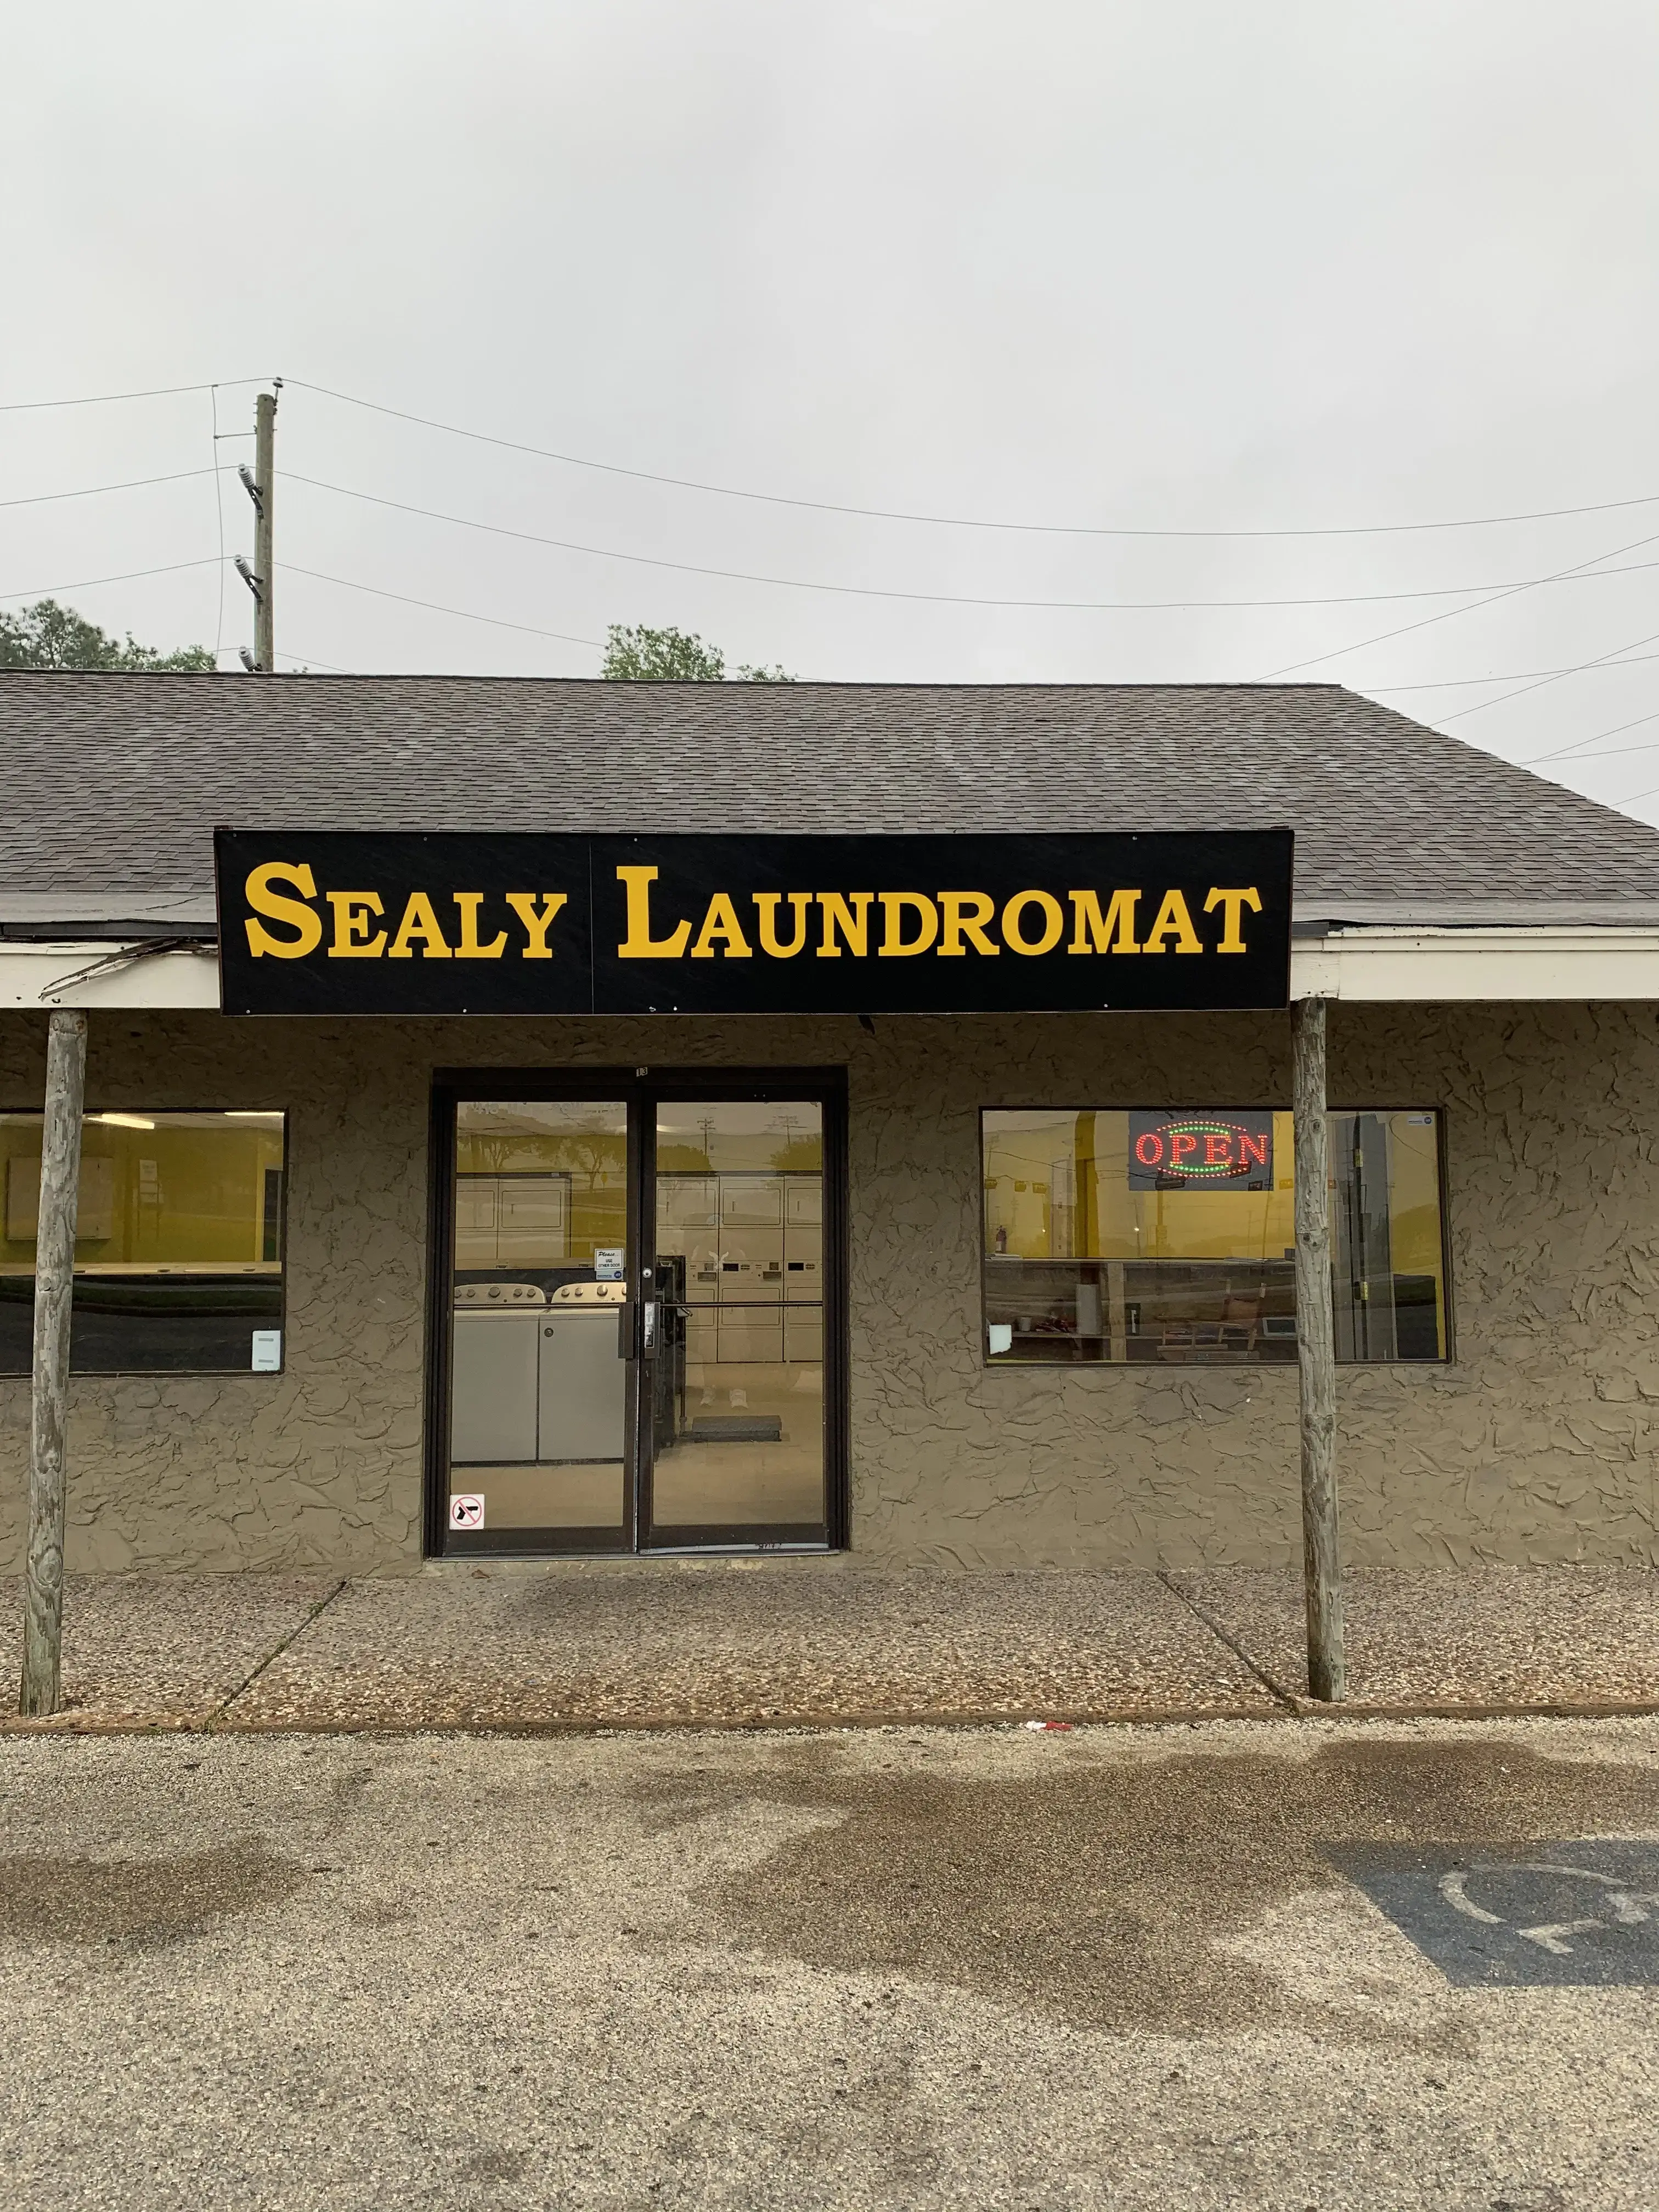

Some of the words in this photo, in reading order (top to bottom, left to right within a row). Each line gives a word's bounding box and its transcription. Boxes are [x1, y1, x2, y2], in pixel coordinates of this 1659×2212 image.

[245, 862, 567, 958] SEALY
[617, 866, 1262, 958] LAUNDROMAT
[1135, 1133, 1268, 1164] OPEN
